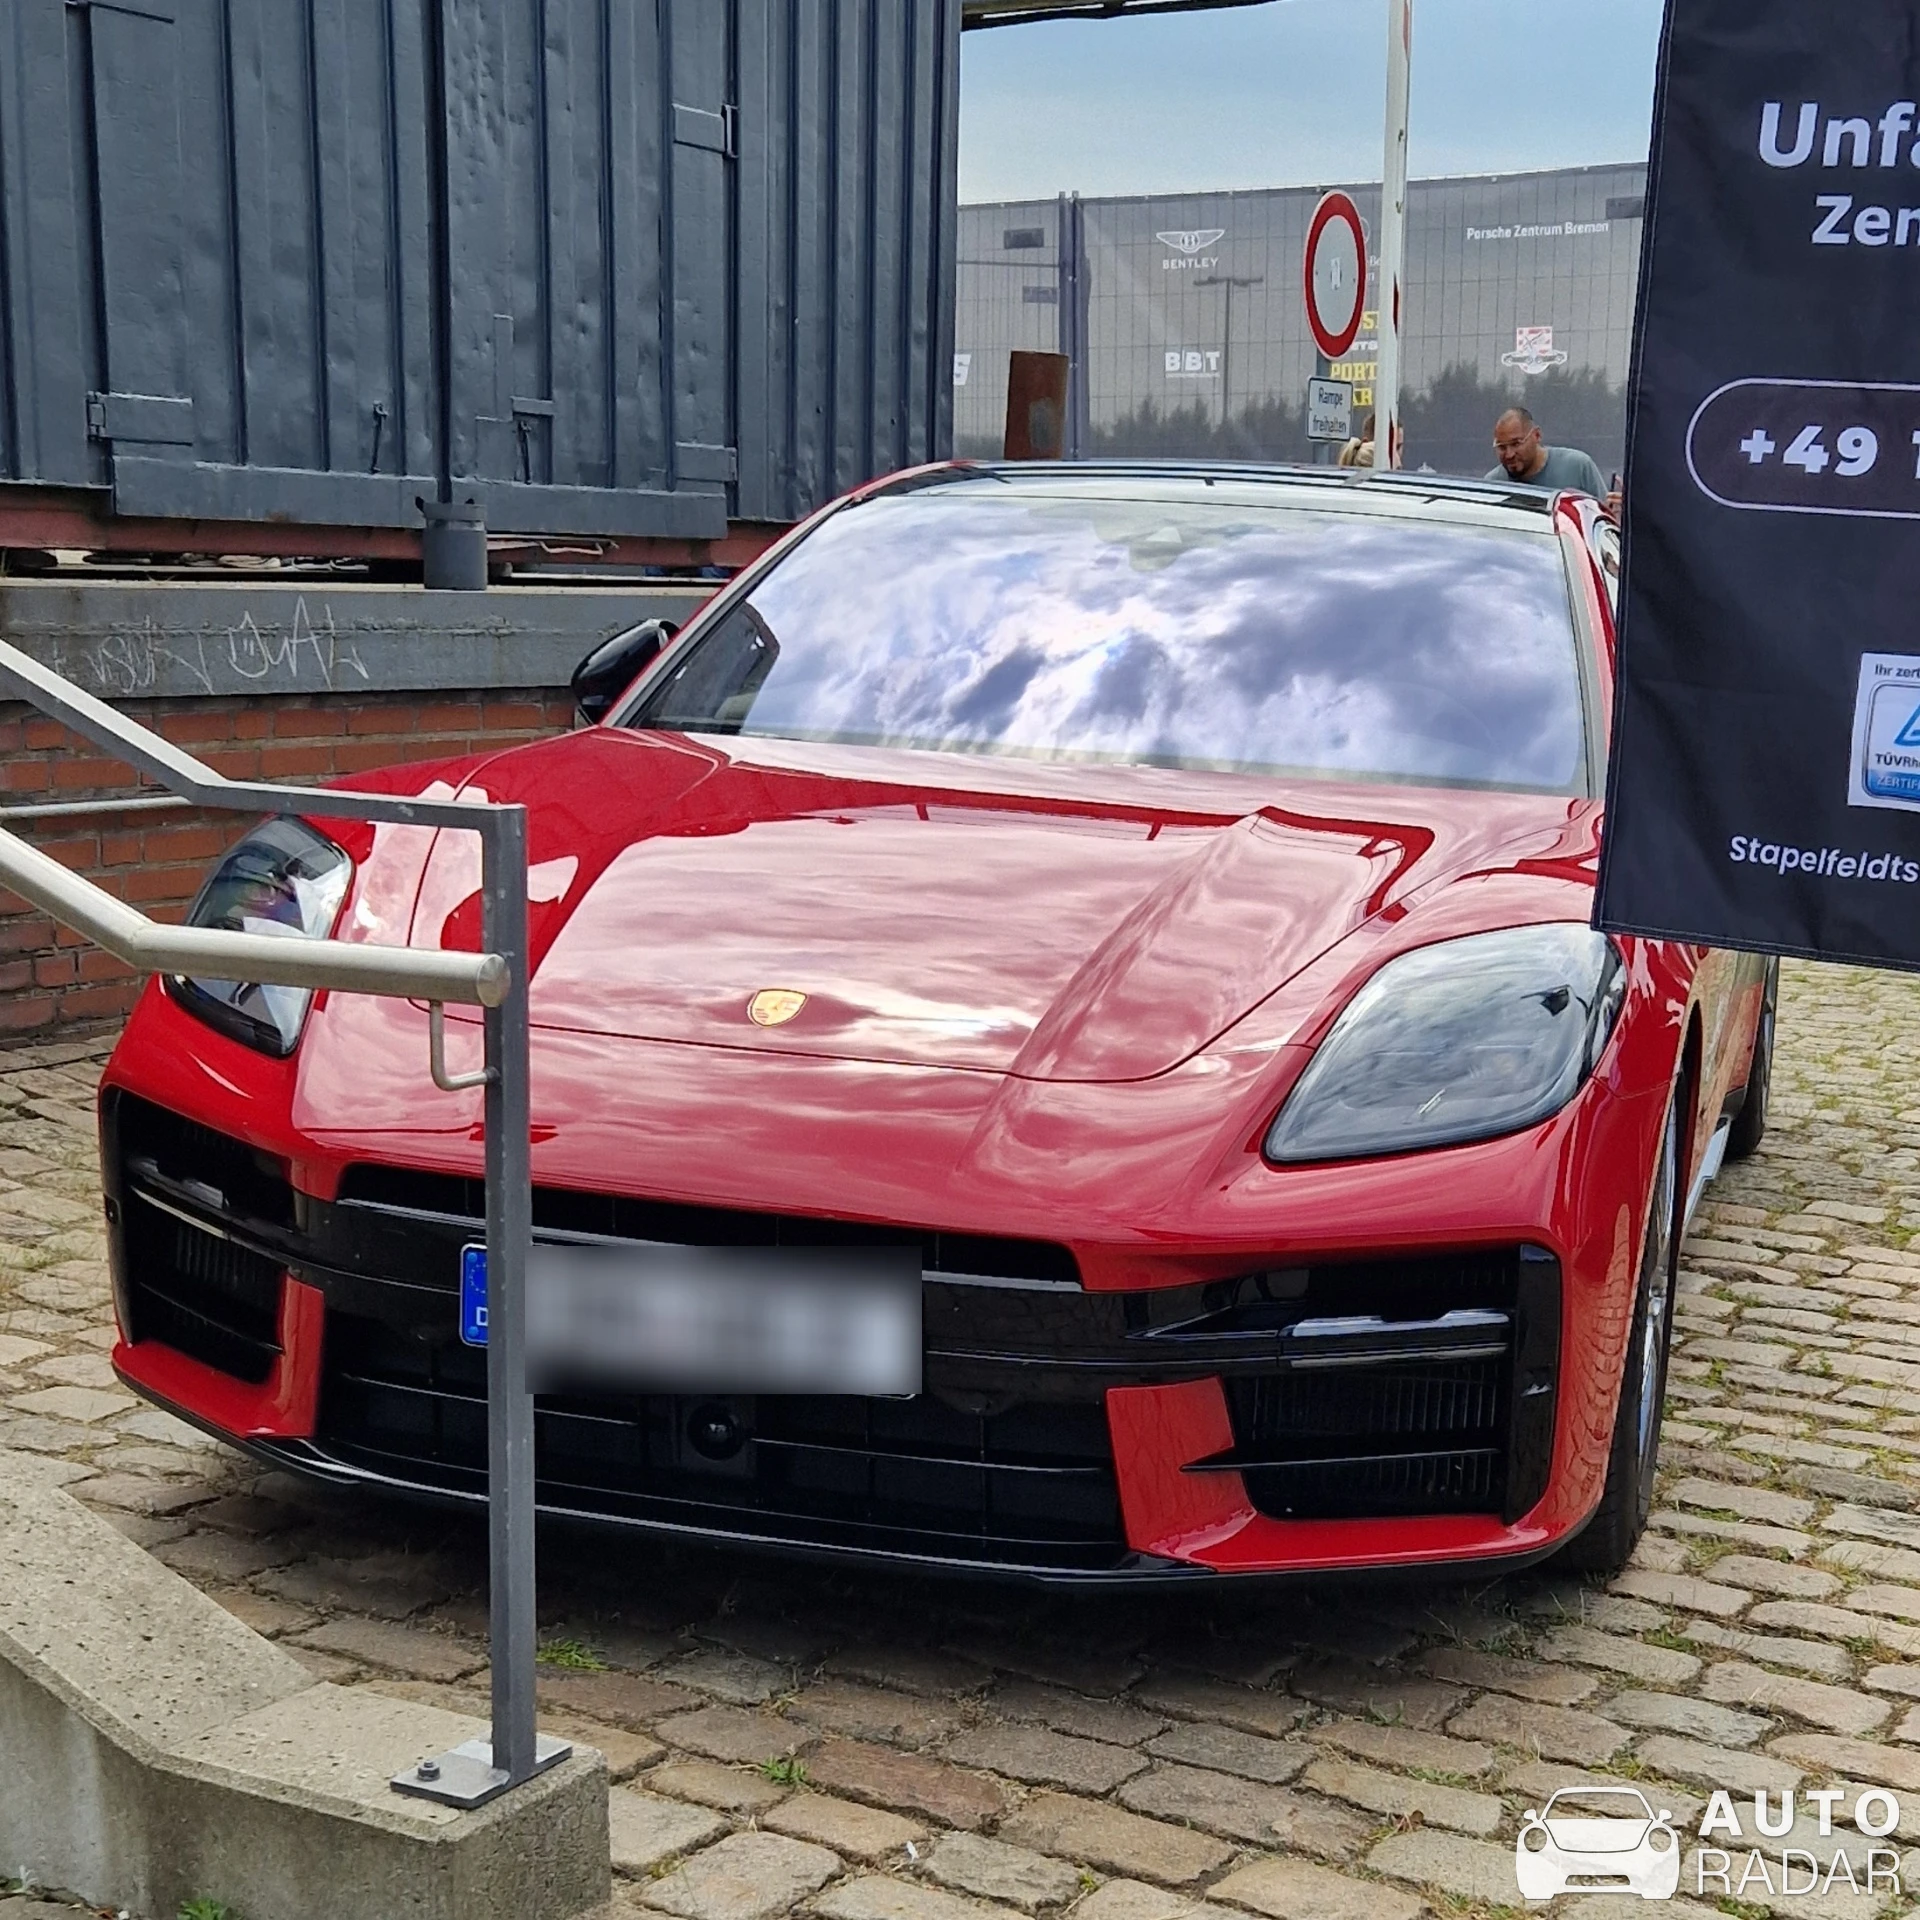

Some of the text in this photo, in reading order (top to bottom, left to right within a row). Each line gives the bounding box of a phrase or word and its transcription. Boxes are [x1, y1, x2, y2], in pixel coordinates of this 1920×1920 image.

[1758, 101, 1920, 168] Unf
[1466, 221, 1609, 240] Porsche Zentrum Bremen
[1162, 257, 1219, 270] BENTLEY
[1318, 386, 1343, 408] Rampe
[1740, 425, 1878, 477] +49
[1874, 663, 1893, 676] Ihr
[1875, 751, 1920, 768] TÜVRh
[1729, 835, 1920, 883] Stapelfeldts
